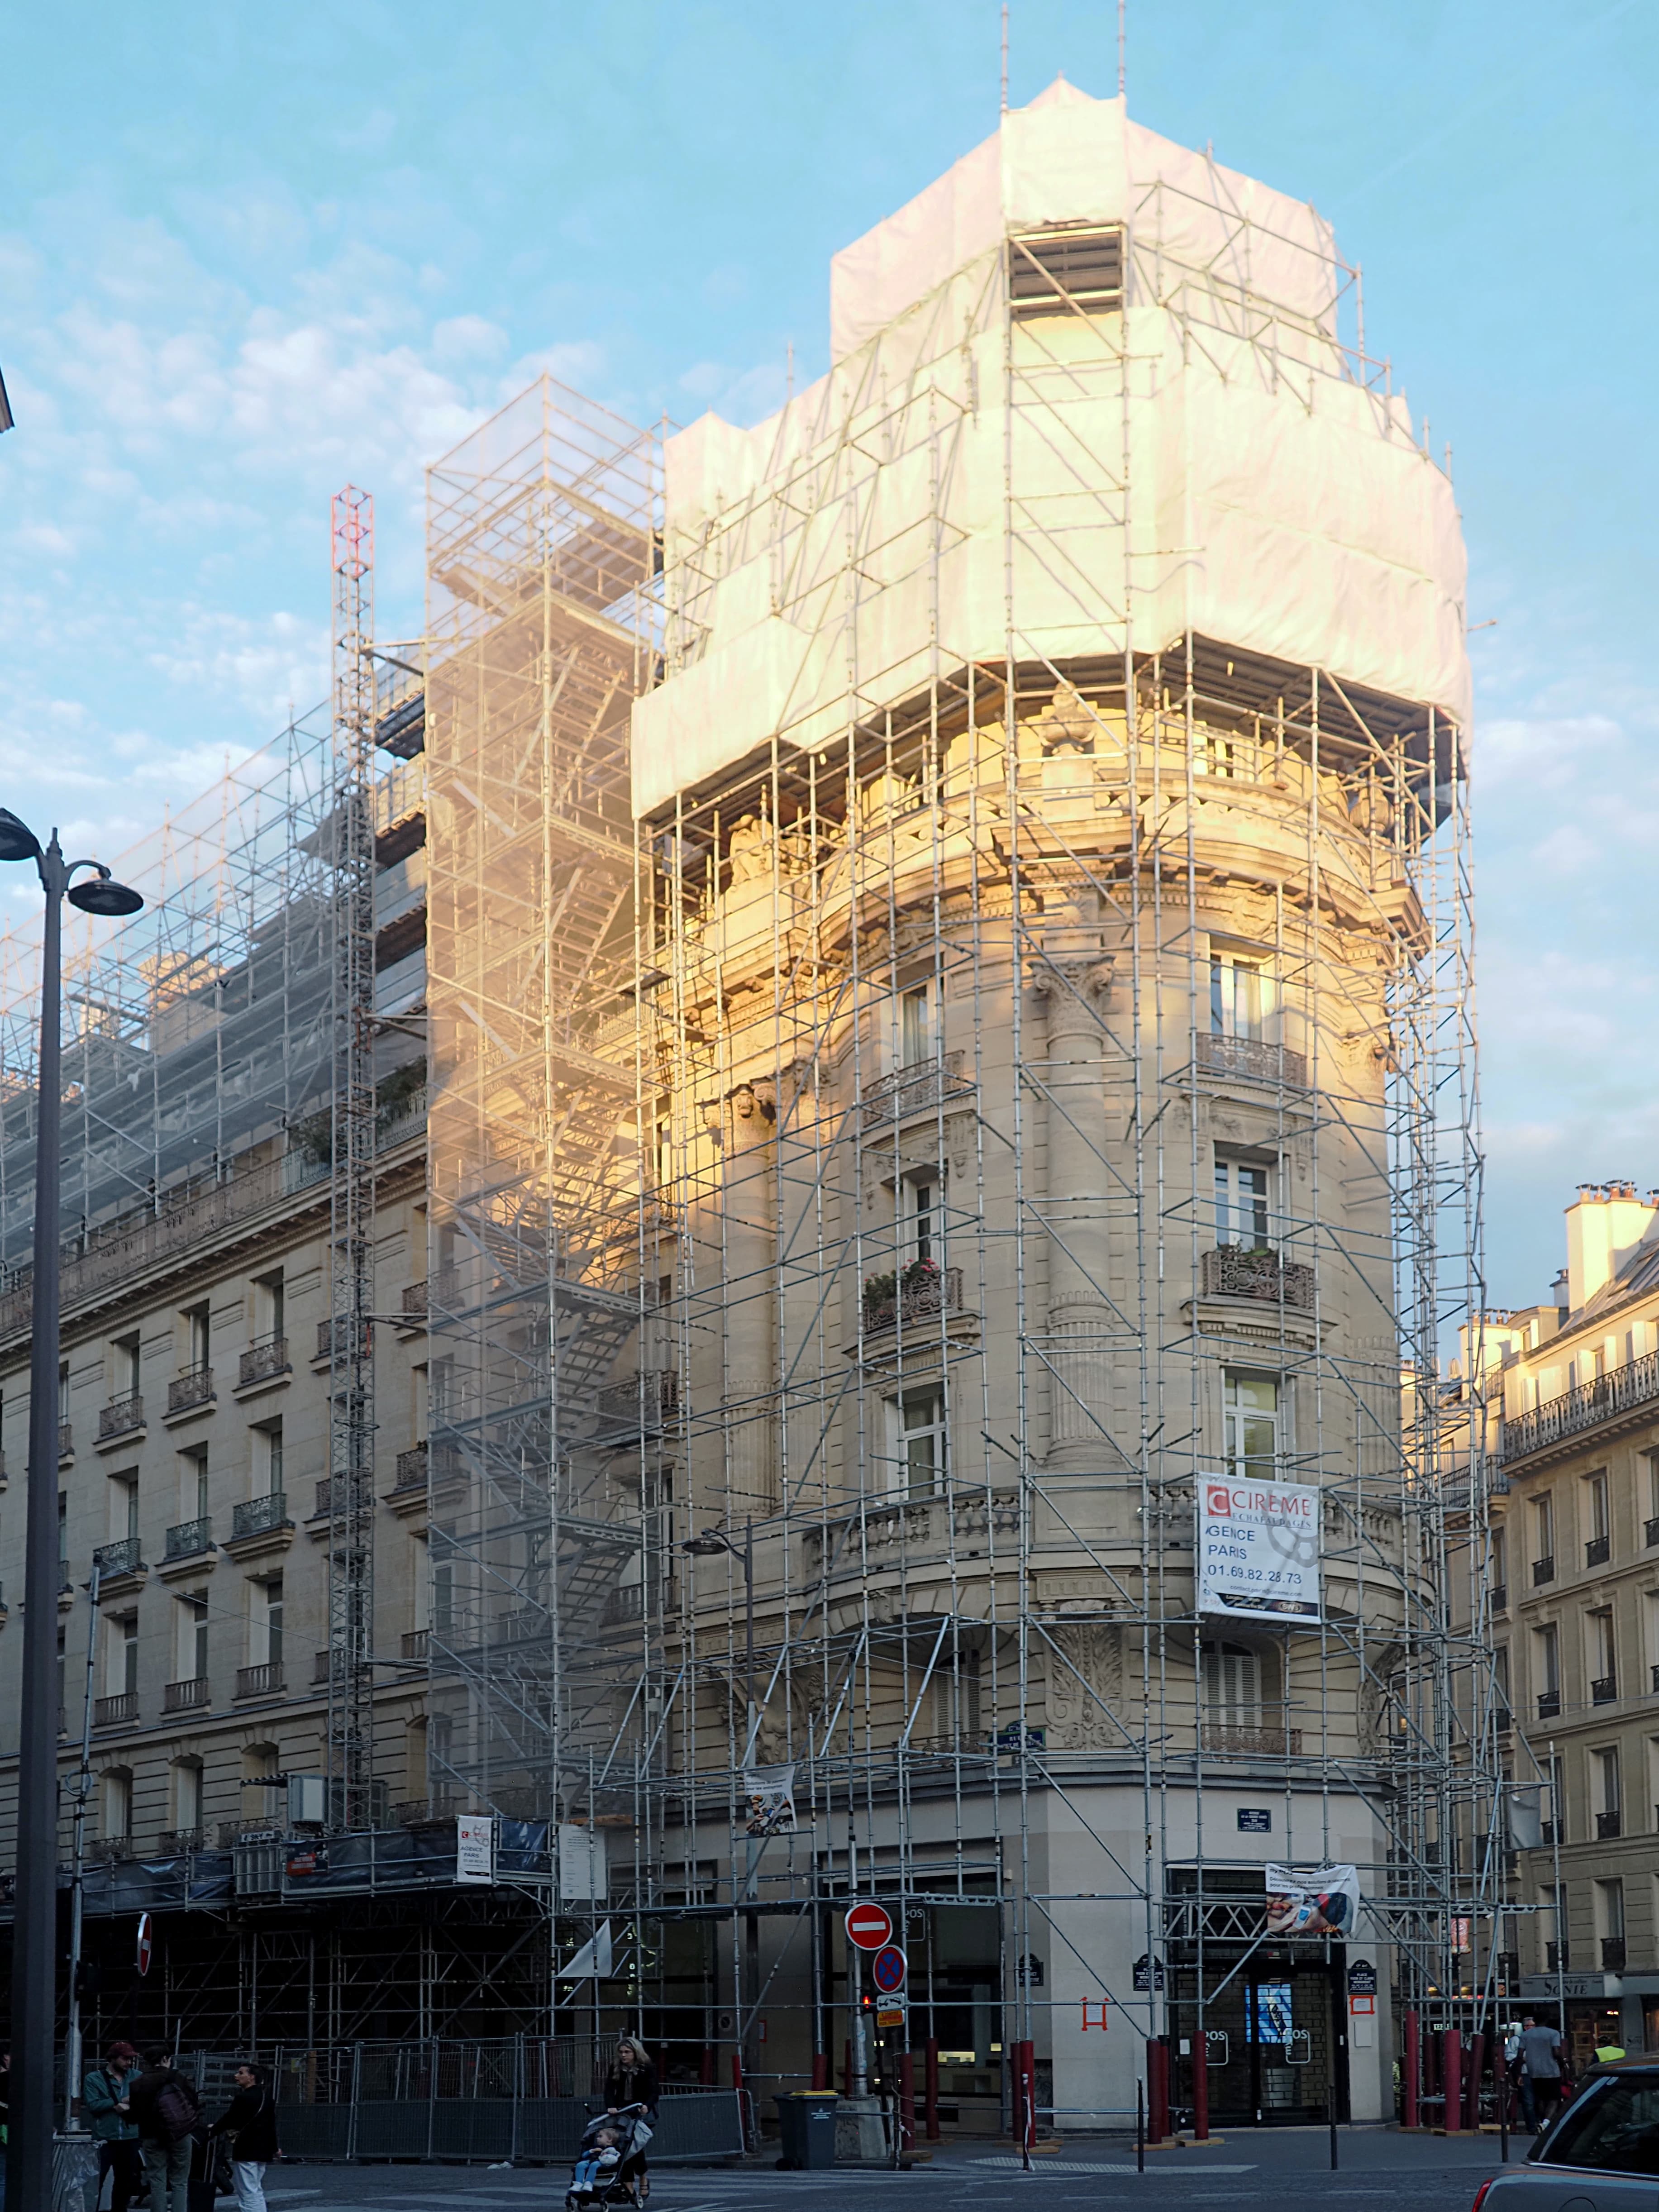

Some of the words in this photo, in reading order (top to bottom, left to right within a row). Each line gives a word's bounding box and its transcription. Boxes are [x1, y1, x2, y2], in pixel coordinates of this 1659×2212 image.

[1232, 1491, 1311, 1516] CIREME
[1209, 1545, 1247, 1559] PARIS
[1208, 1564, 1302, 1584] 01.69.82.28.73
